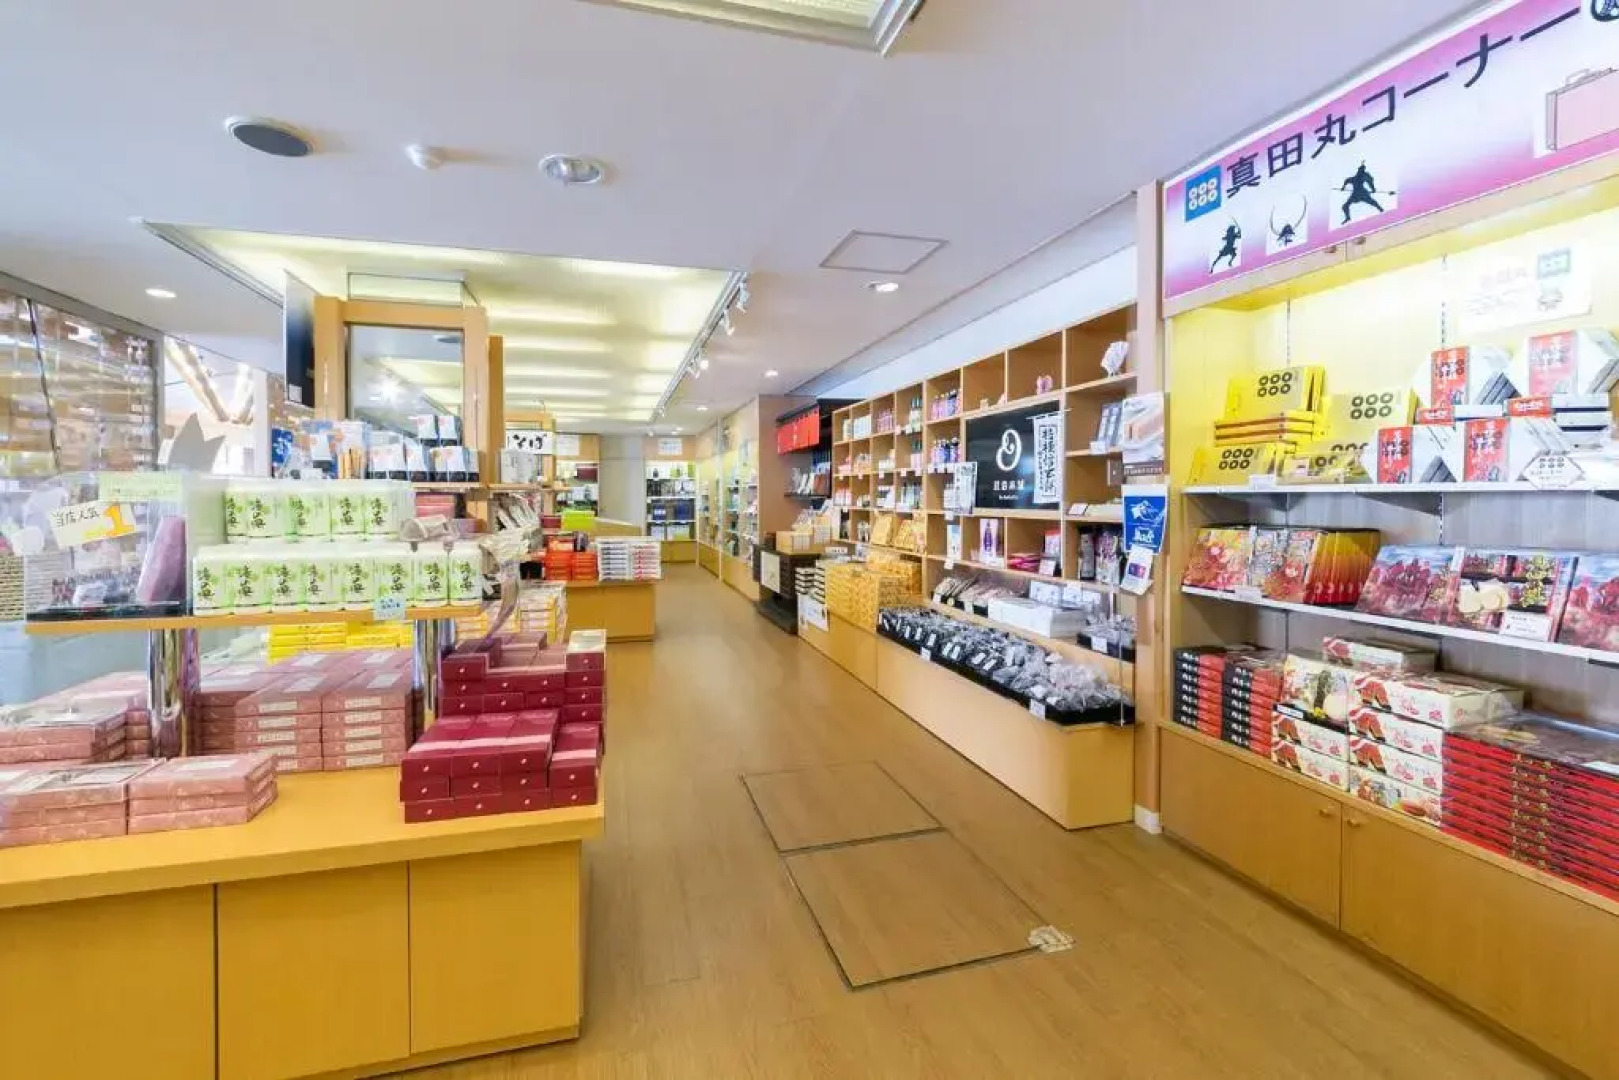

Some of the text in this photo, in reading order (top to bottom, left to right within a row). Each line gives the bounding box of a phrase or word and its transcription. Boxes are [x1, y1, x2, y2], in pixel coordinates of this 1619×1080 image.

[1227, 7, 1581, 198] 真田丸コーナー
